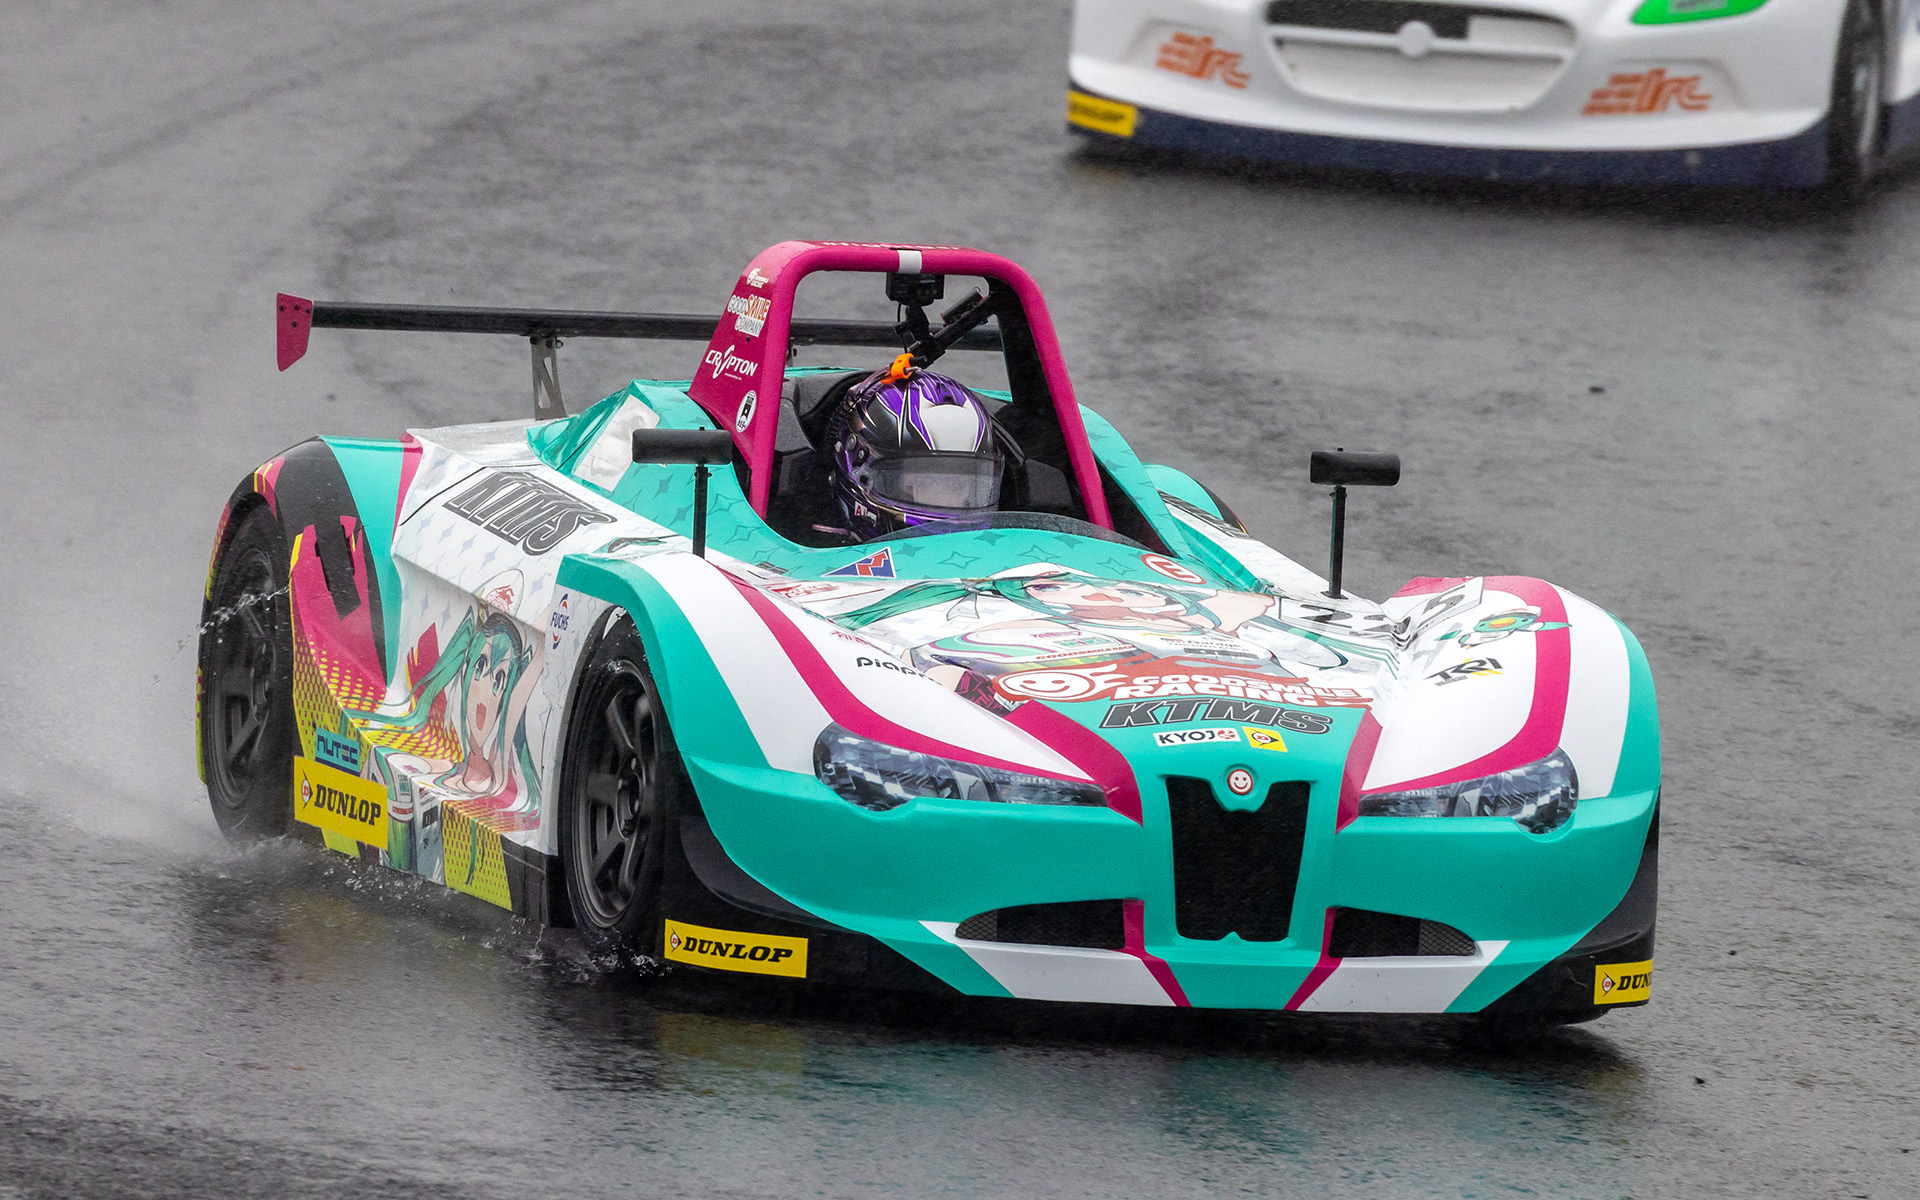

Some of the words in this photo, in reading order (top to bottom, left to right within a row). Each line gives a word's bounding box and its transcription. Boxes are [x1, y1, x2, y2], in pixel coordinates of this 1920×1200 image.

[705, 344, 758, 379] CRYPTON
[551, 611, 569, 631] FUCHS
[1035, 647, 1111, 659] GOODSMILE
[856, 656, 943, 686] piap
[1114, 683, 1319, 707] RACING
[1132, 674, 1364, 699] GOODSMILE
[1099, 697, 1333, 734] KTMS
[314, 783, 381, 826] DUNLOP
[683, 936, 793, 963] DUNLOP
